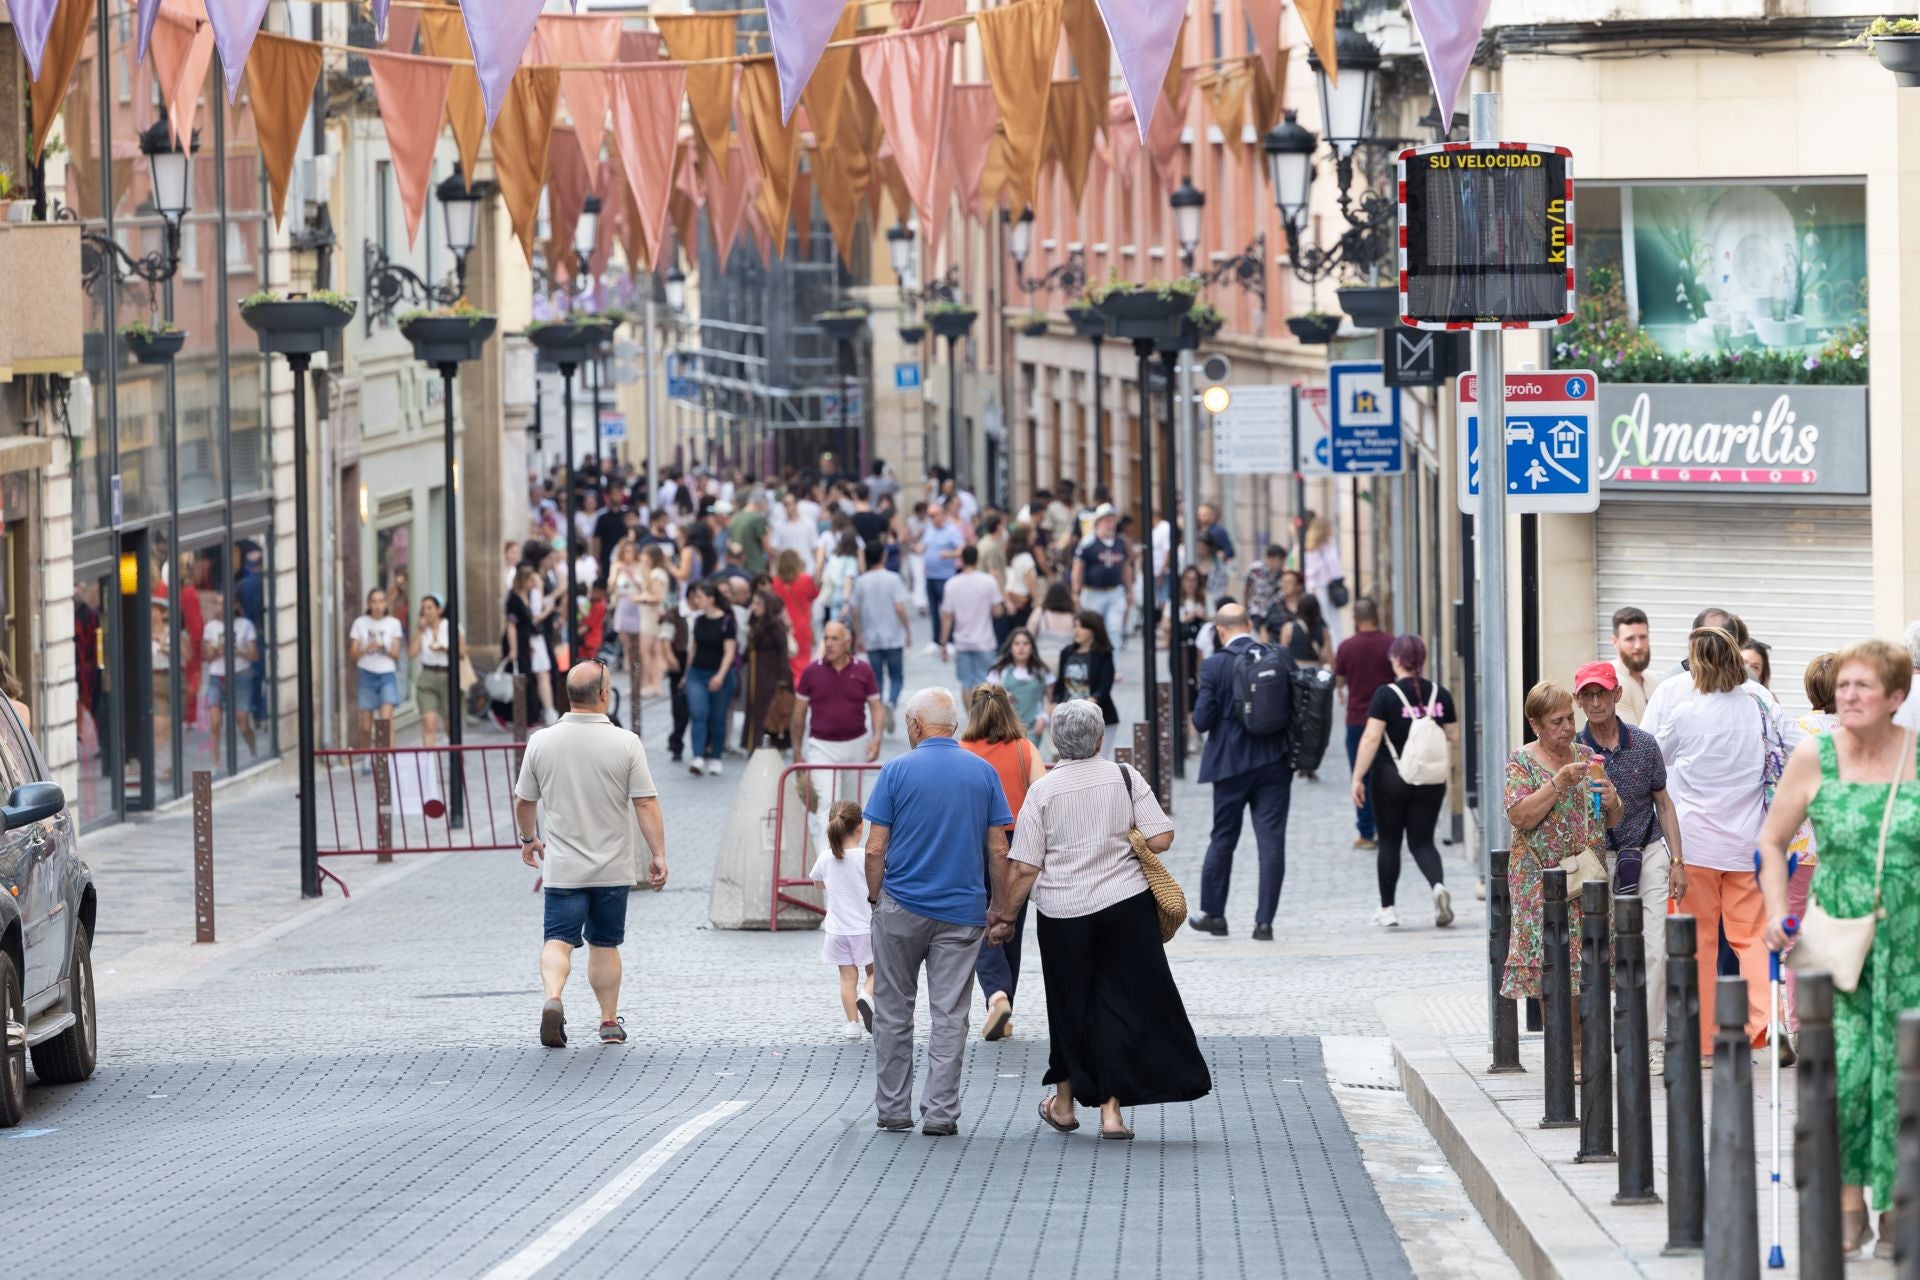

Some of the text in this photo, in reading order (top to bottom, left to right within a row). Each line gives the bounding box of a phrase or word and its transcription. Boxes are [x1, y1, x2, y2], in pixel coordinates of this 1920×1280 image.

[1429, 154, 1542, 169] SU VELOCIDAD
[1546, 199, 1566, 263] km/h
[1504, 383, 1543, 397] groño
[1599, 392, 1819, 481] Amarilis
[1622, 468, 1812, 482] REGALOS
